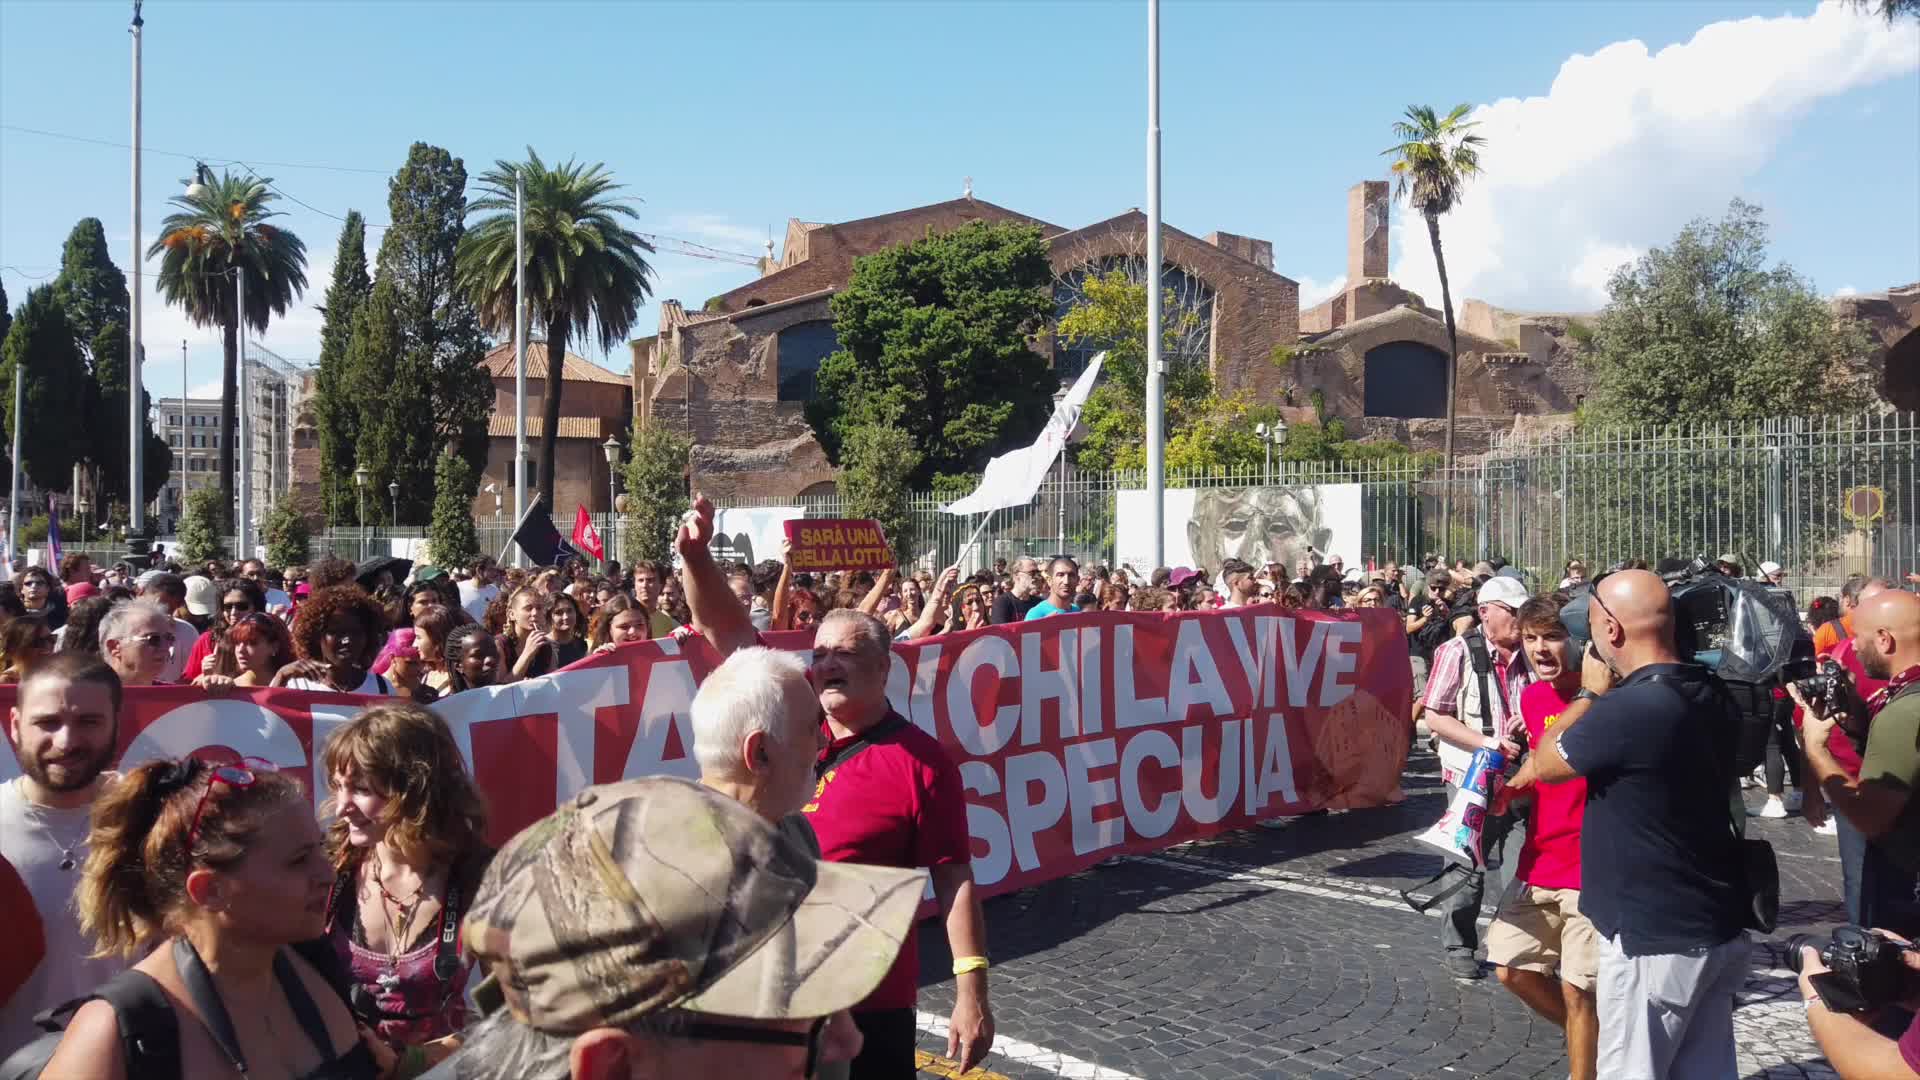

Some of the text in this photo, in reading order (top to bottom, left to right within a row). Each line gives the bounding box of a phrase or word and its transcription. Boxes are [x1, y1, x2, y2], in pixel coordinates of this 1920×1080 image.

[847, 527, 880, 545] UNA
[792, 548, 891, 567] BELLA LOTTA
[947, 626, 1104, 756] CHI
[1114, 619, 1235, 729] LA
[1224, 616, 1362, 710] VIVE
[442, 911, 457, 943] EOS
